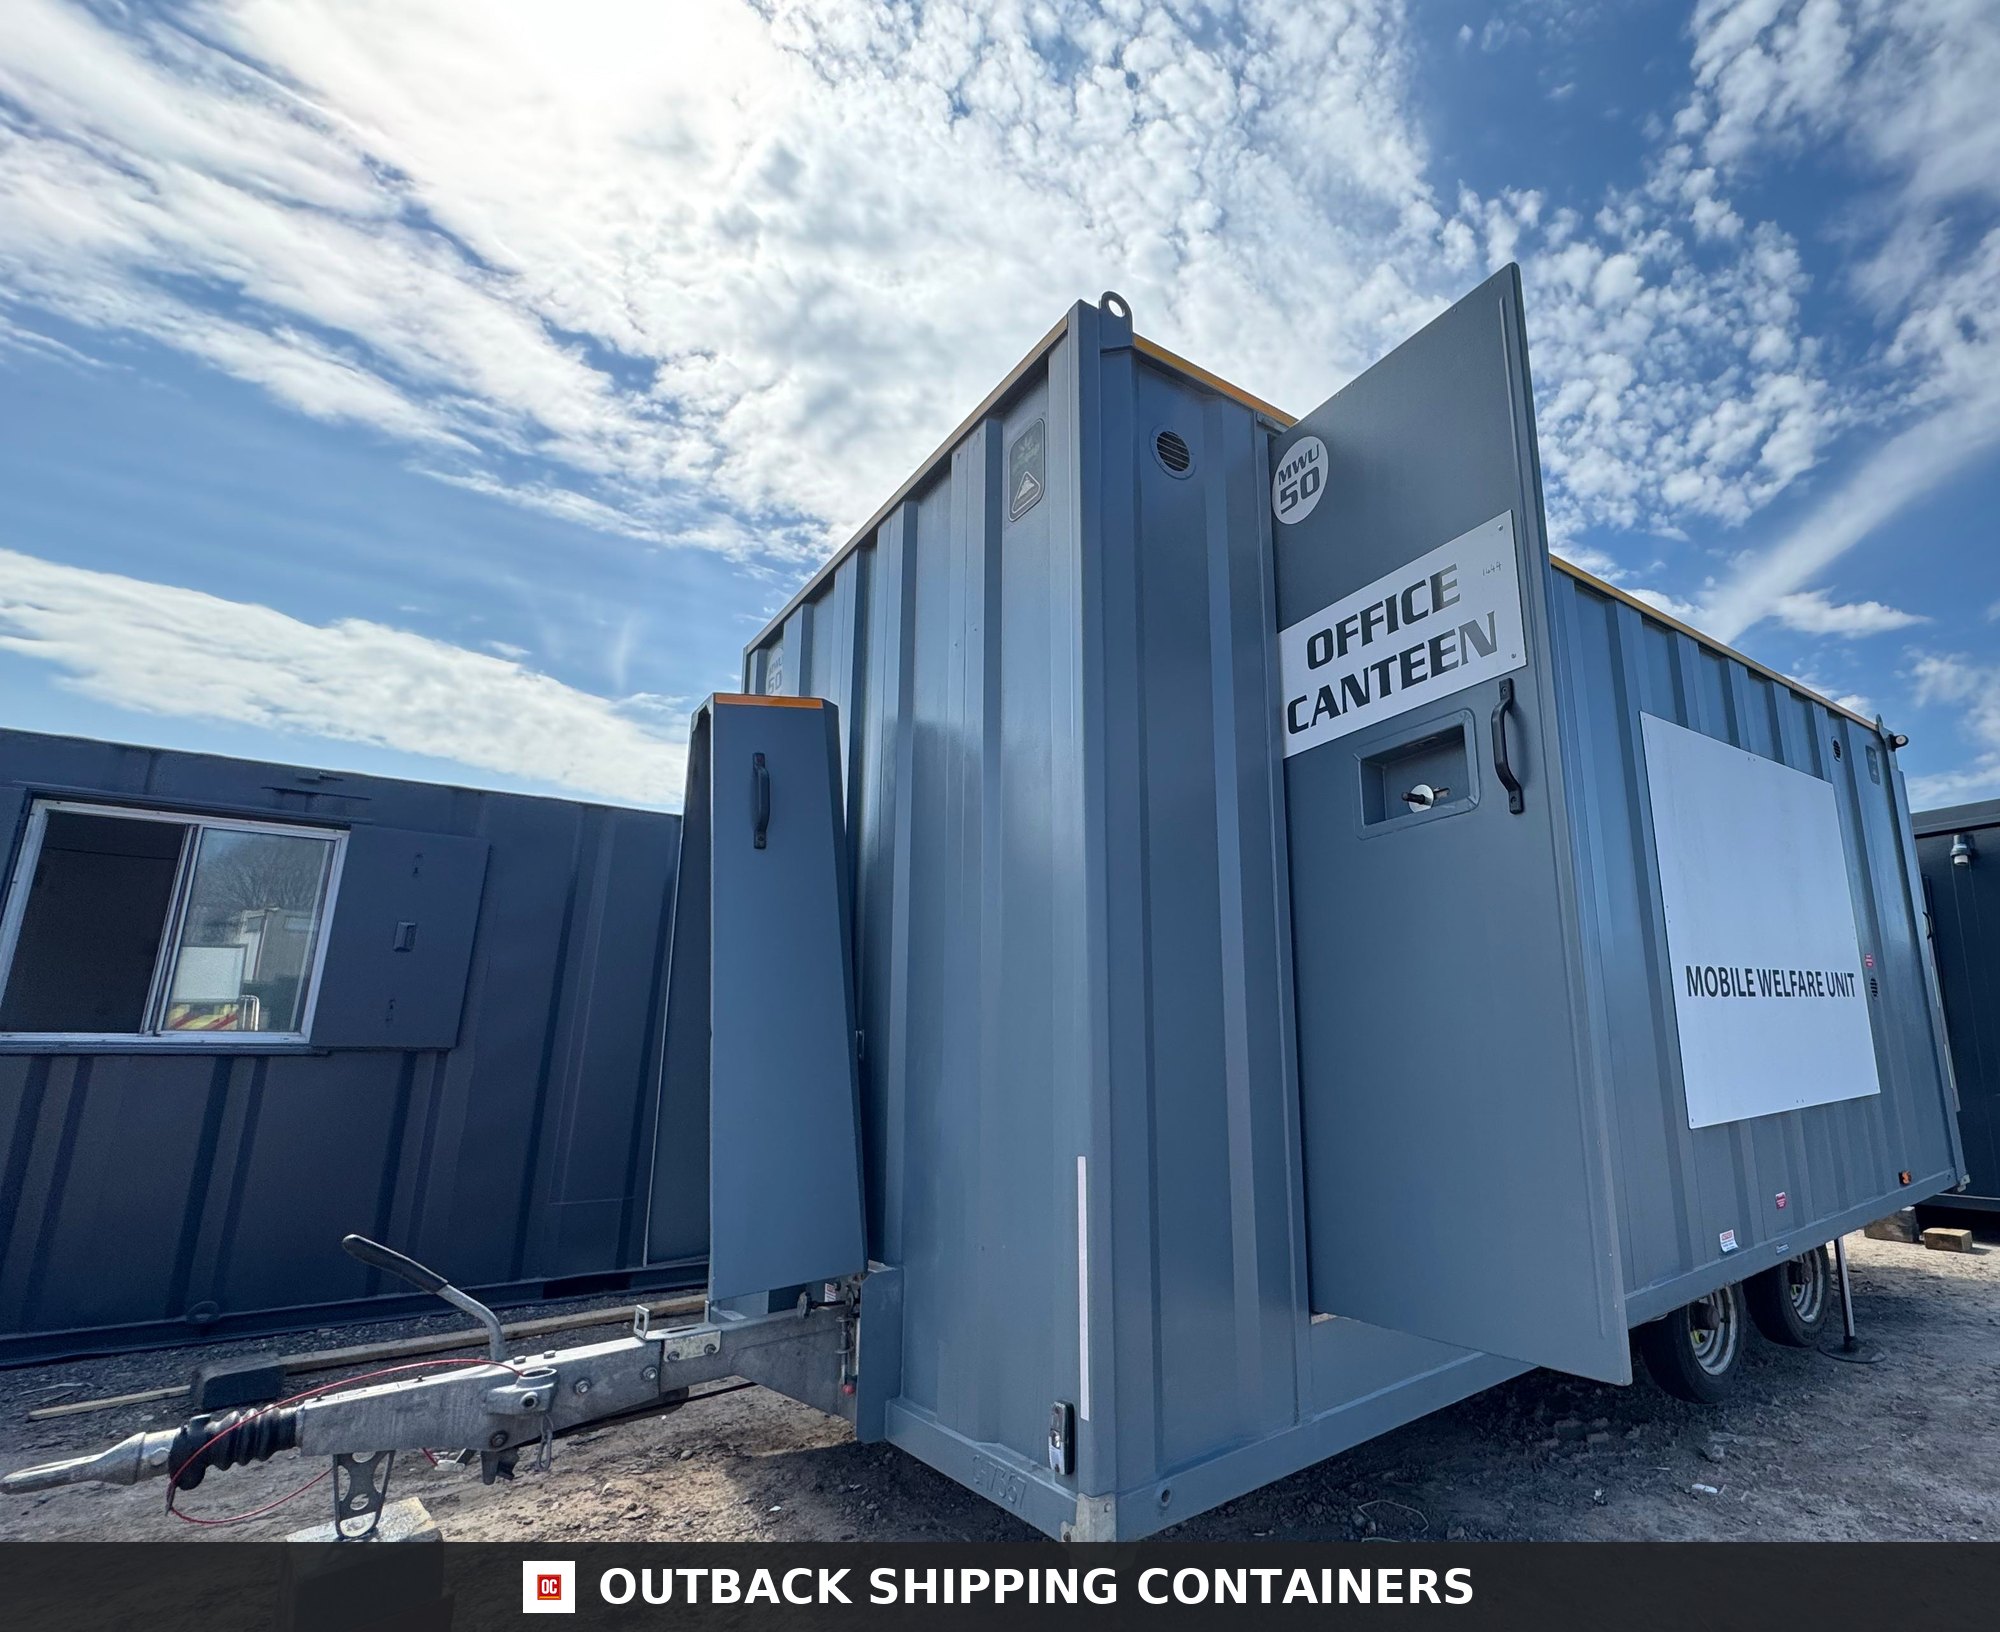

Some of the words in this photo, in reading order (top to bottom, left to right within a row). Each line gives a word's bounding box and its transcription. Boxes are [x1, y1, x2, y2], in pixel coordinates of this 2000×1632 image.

[1278, 443, 1320, 485] MWU
[1280, 466, 1320, 515] 50
[1306, 563, 1461, 671] OFFICE
[1287, 610, 1498, 735] CANTEEN
[1685, 965, 1756, 998] MOBILE
[1756, 968, 1825, 998] WELFARE
[1825, 971, 1856, 998] UNIT
